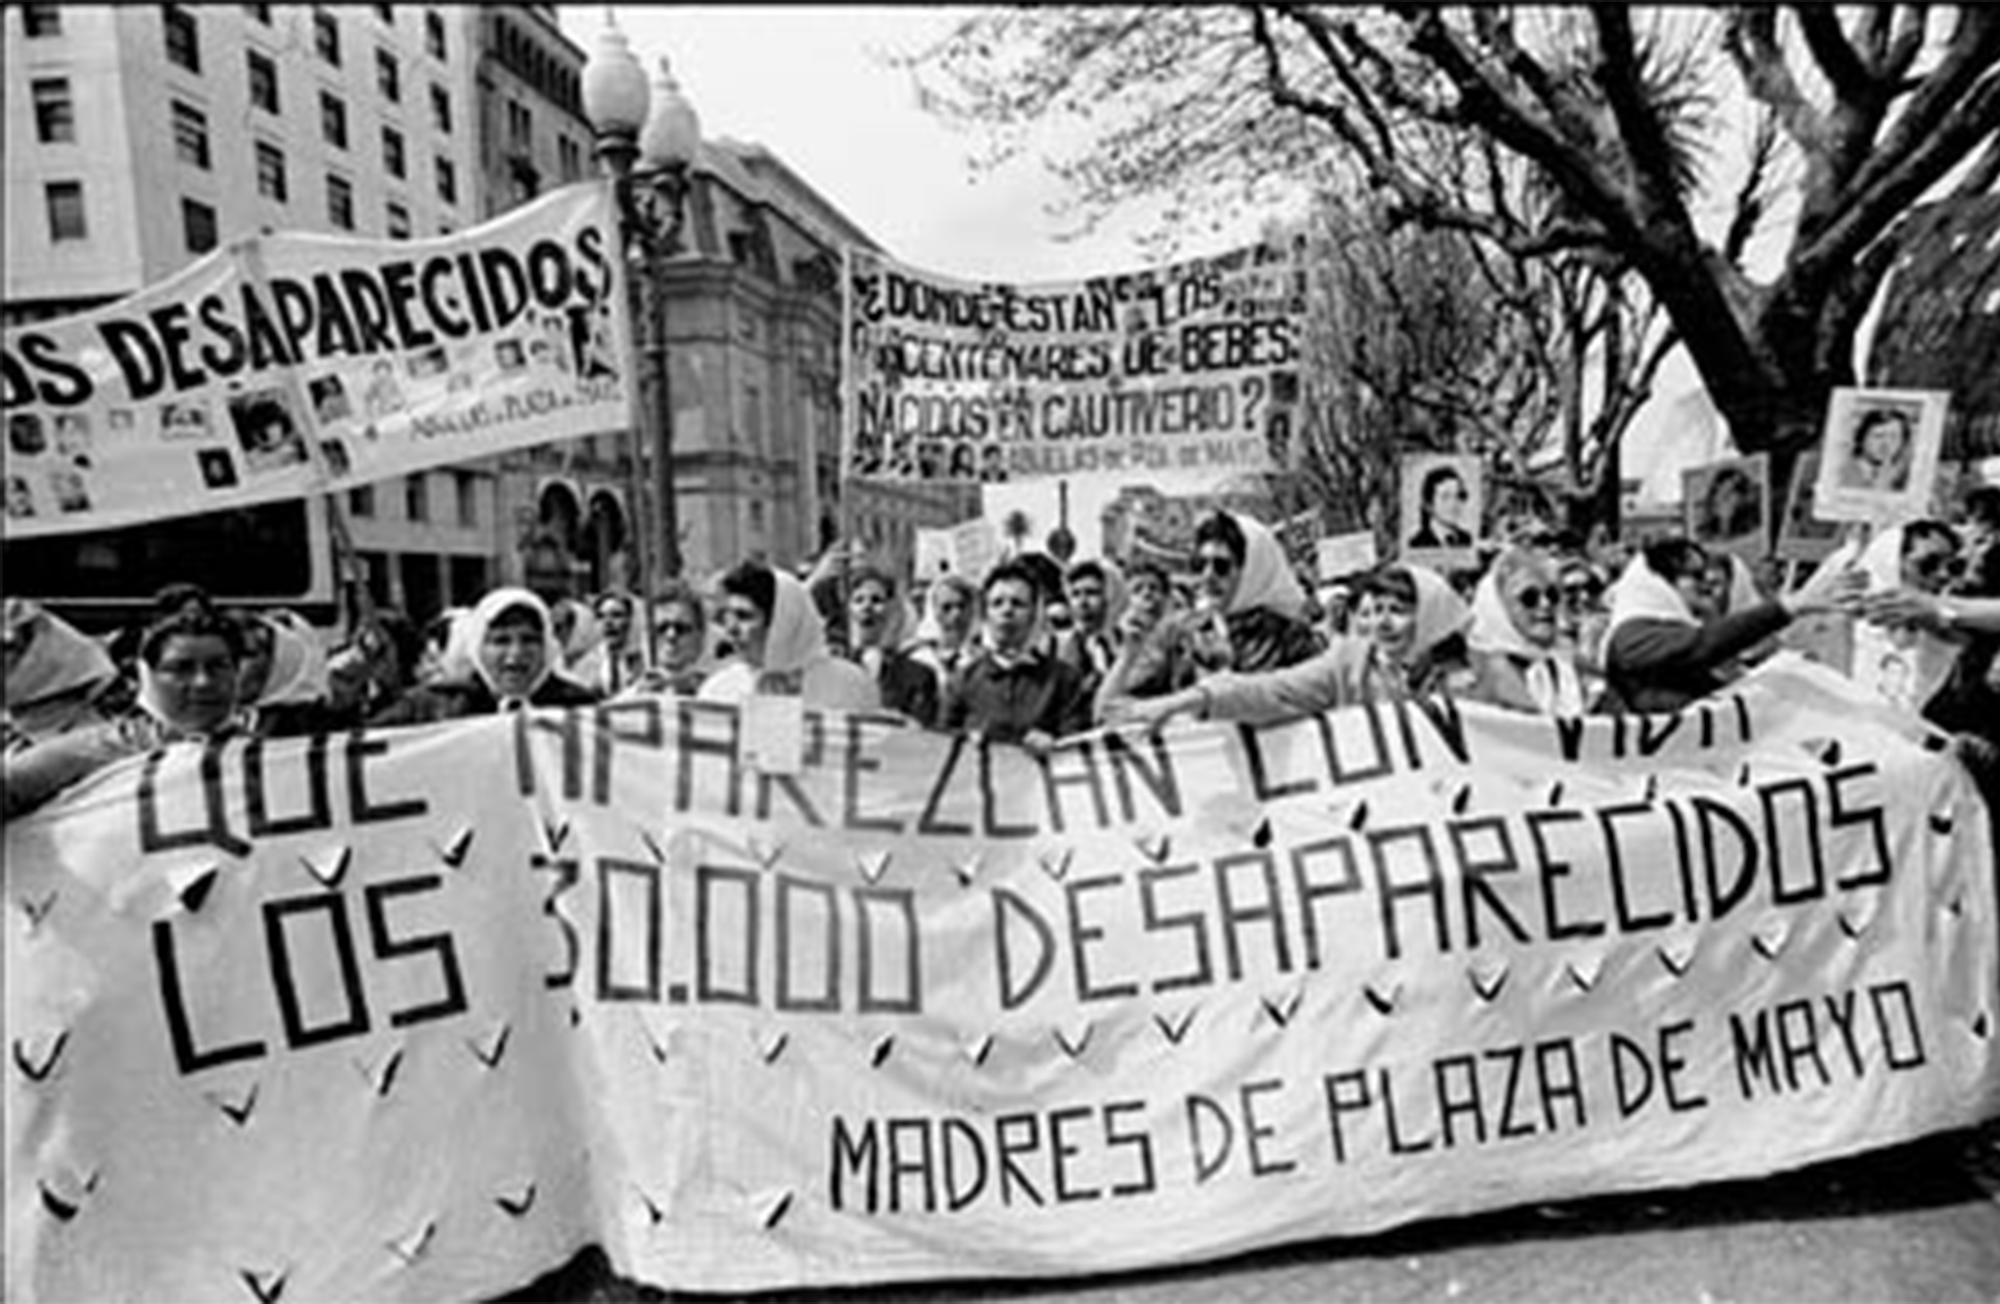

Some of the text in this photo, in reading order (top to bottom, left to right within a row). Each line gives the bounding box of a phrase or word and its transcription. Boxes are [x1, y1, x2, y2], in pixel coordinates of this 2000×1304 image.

[98, 226, 612, 400] DESAPARECIDOS
[1156, 274, 1221, 327] LOS
[1181, 317, 1290, 373] BEBES
[138, 735, 427, 857] QUE
[1238, 692, 1470, 799] CON
[152, 874, 468, 1074] LOS
[991, 763, 1893, 1011] DESAPARECIDOS
[829, 980, 1926, 1215] MADRES DE PLAZA DE MAYO
